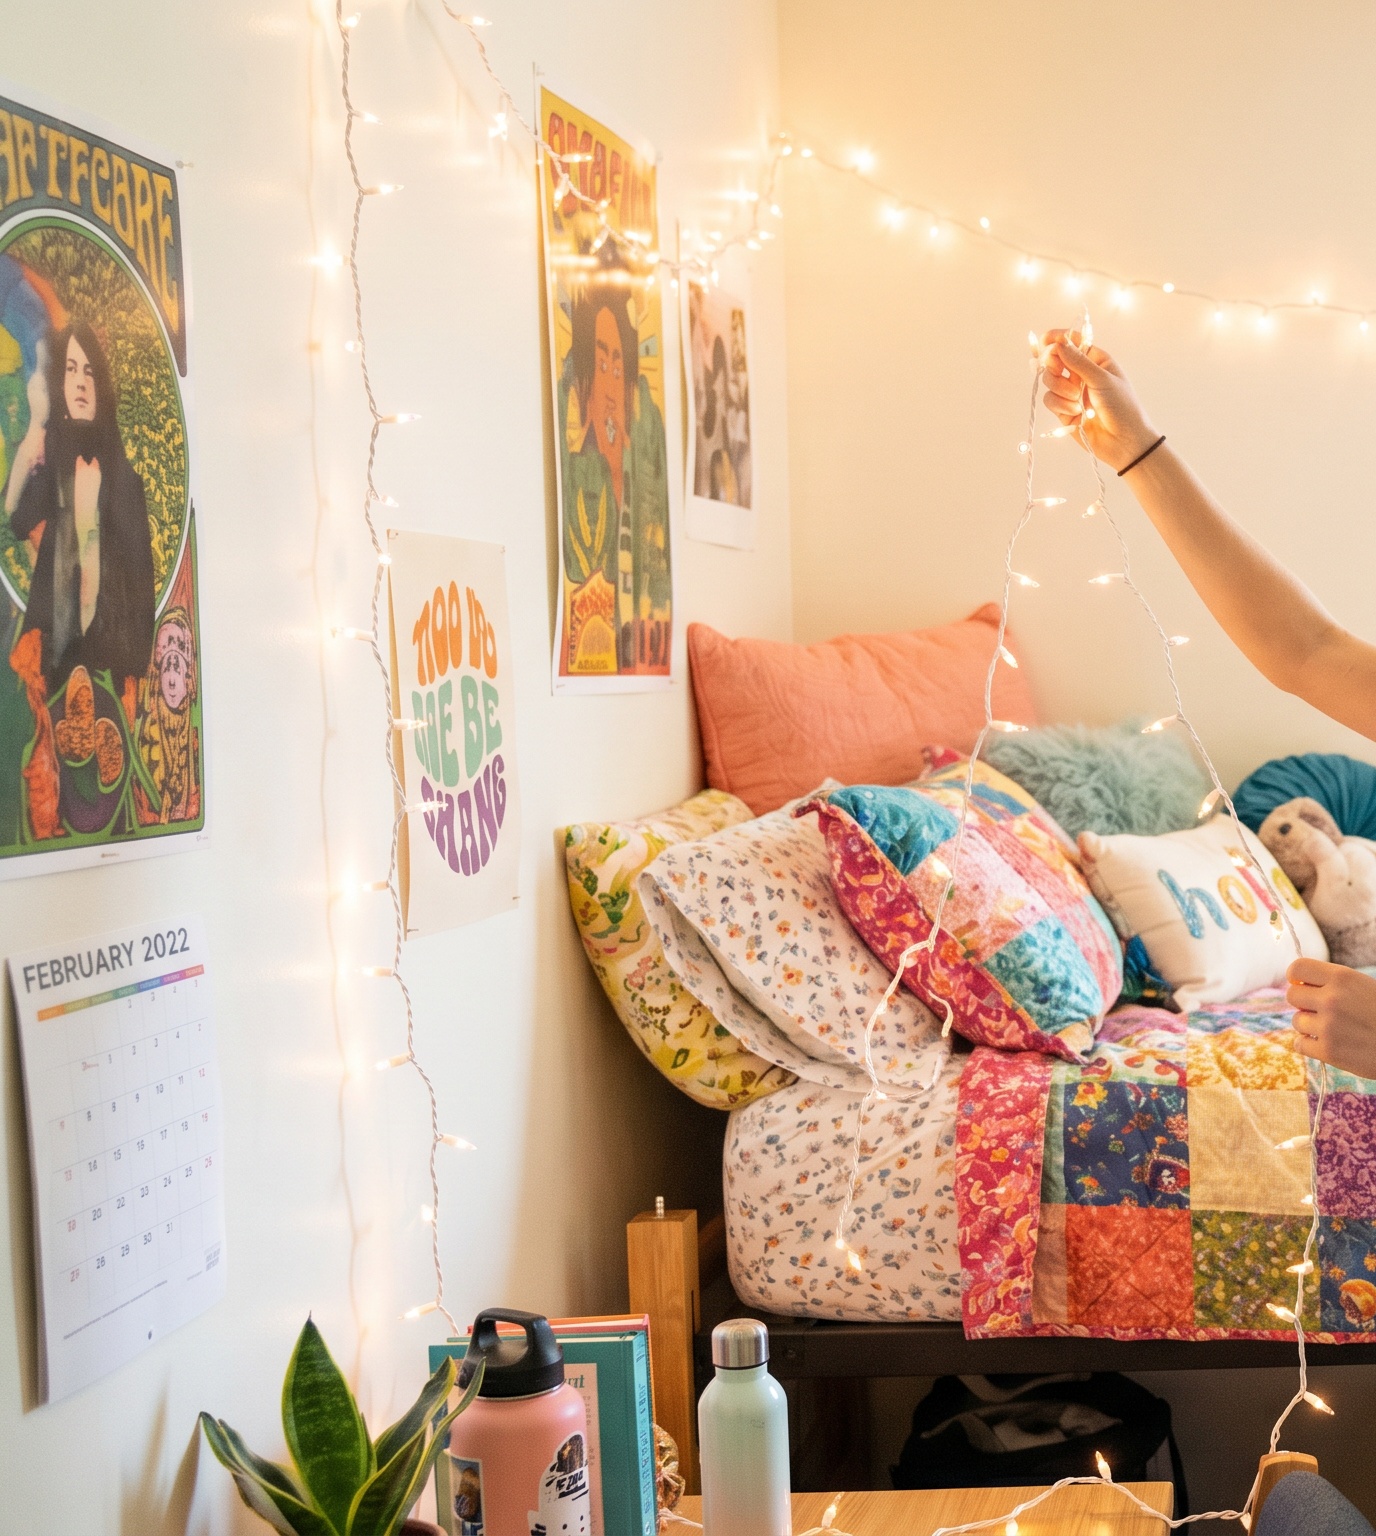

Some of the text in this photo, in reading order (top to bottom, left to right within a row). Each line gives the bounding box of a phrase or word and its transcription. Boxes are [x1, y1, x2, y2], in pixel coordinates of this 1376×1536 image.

[460, 675, 503, 779] BE
[23, 940, 134, 994] FEBRUARY
[141, 927, 190, 962] 2022
[155, 1083, 164, 1094] 10
[178, 1075, 184, 1085] 11
[160, 1128, 167, 1140] 17
[91, 1207, 102, 1221] 20
[116, 1196, 126, 1209] 22
[143, 1232, 152, 1245] 30
[166, 1222, 173, 1234] 31
